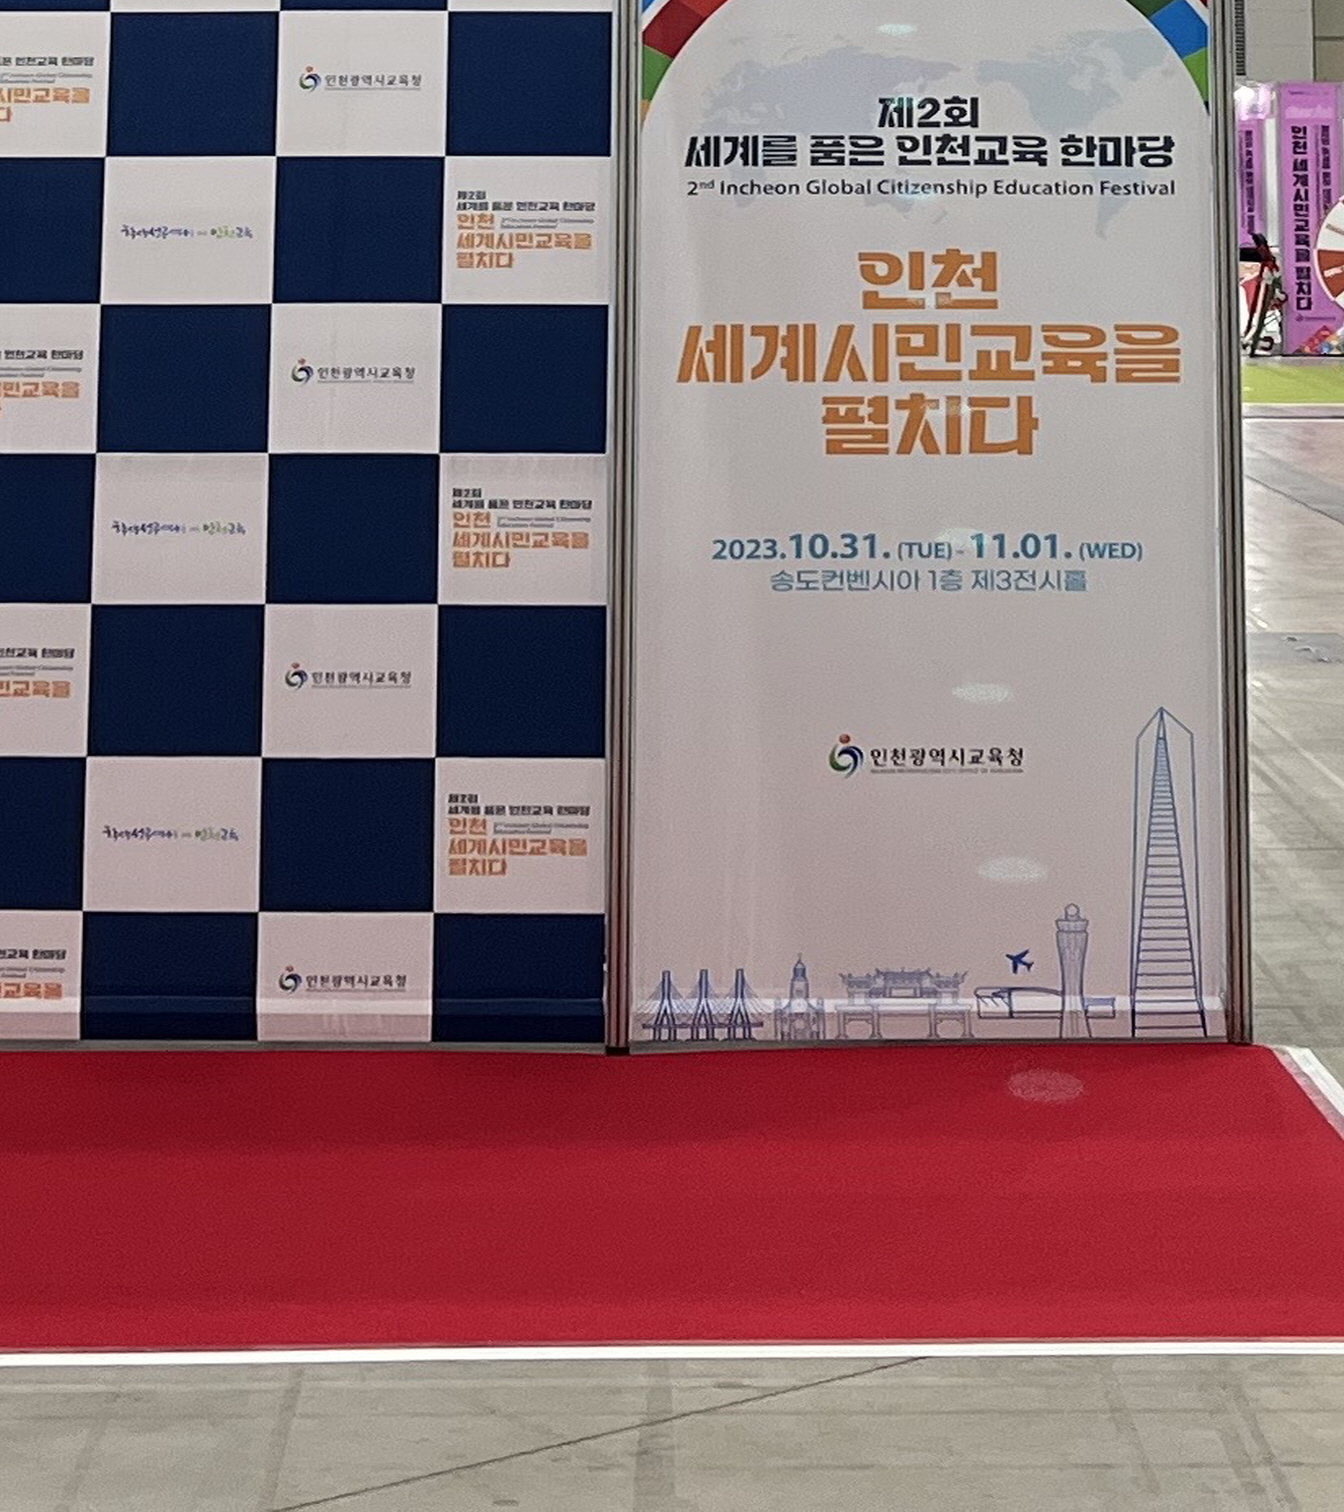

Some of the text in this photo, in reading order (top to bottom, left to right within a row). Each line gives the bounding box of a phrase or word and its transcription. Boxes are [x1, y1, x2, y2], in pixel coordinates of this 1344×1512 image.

[877, 96, 980, 128] 제2회
[685, 133, 1175, 168] 세계를 품은 인천교육 한마당
[687, 179, 1176, 199] 2nd Incheon Global Citizenship Education Festival
[457, 213, 495, 230] 인천
[857, 248, 999, 310] 인천
[676, 323, 1182, 384] 세계시민교육을
[821, 392, 1039, 456] 펼치다
[453, 511, 491, 528] 인천
[712, 532, 891, 561] 2023.10.31.
[896, 540, 953, 562] (TUE)
[968, 532, 1073, 560] 11.01.
[1078, 541, 1144, 563] (WED)
[769, 569, 921, 593] 송도컨벤시아
[928, 569, 963, 592] 1층
[869, 747, 1024, 769] 인천광역시교육청
[448, 818, 487, 835] 인천
